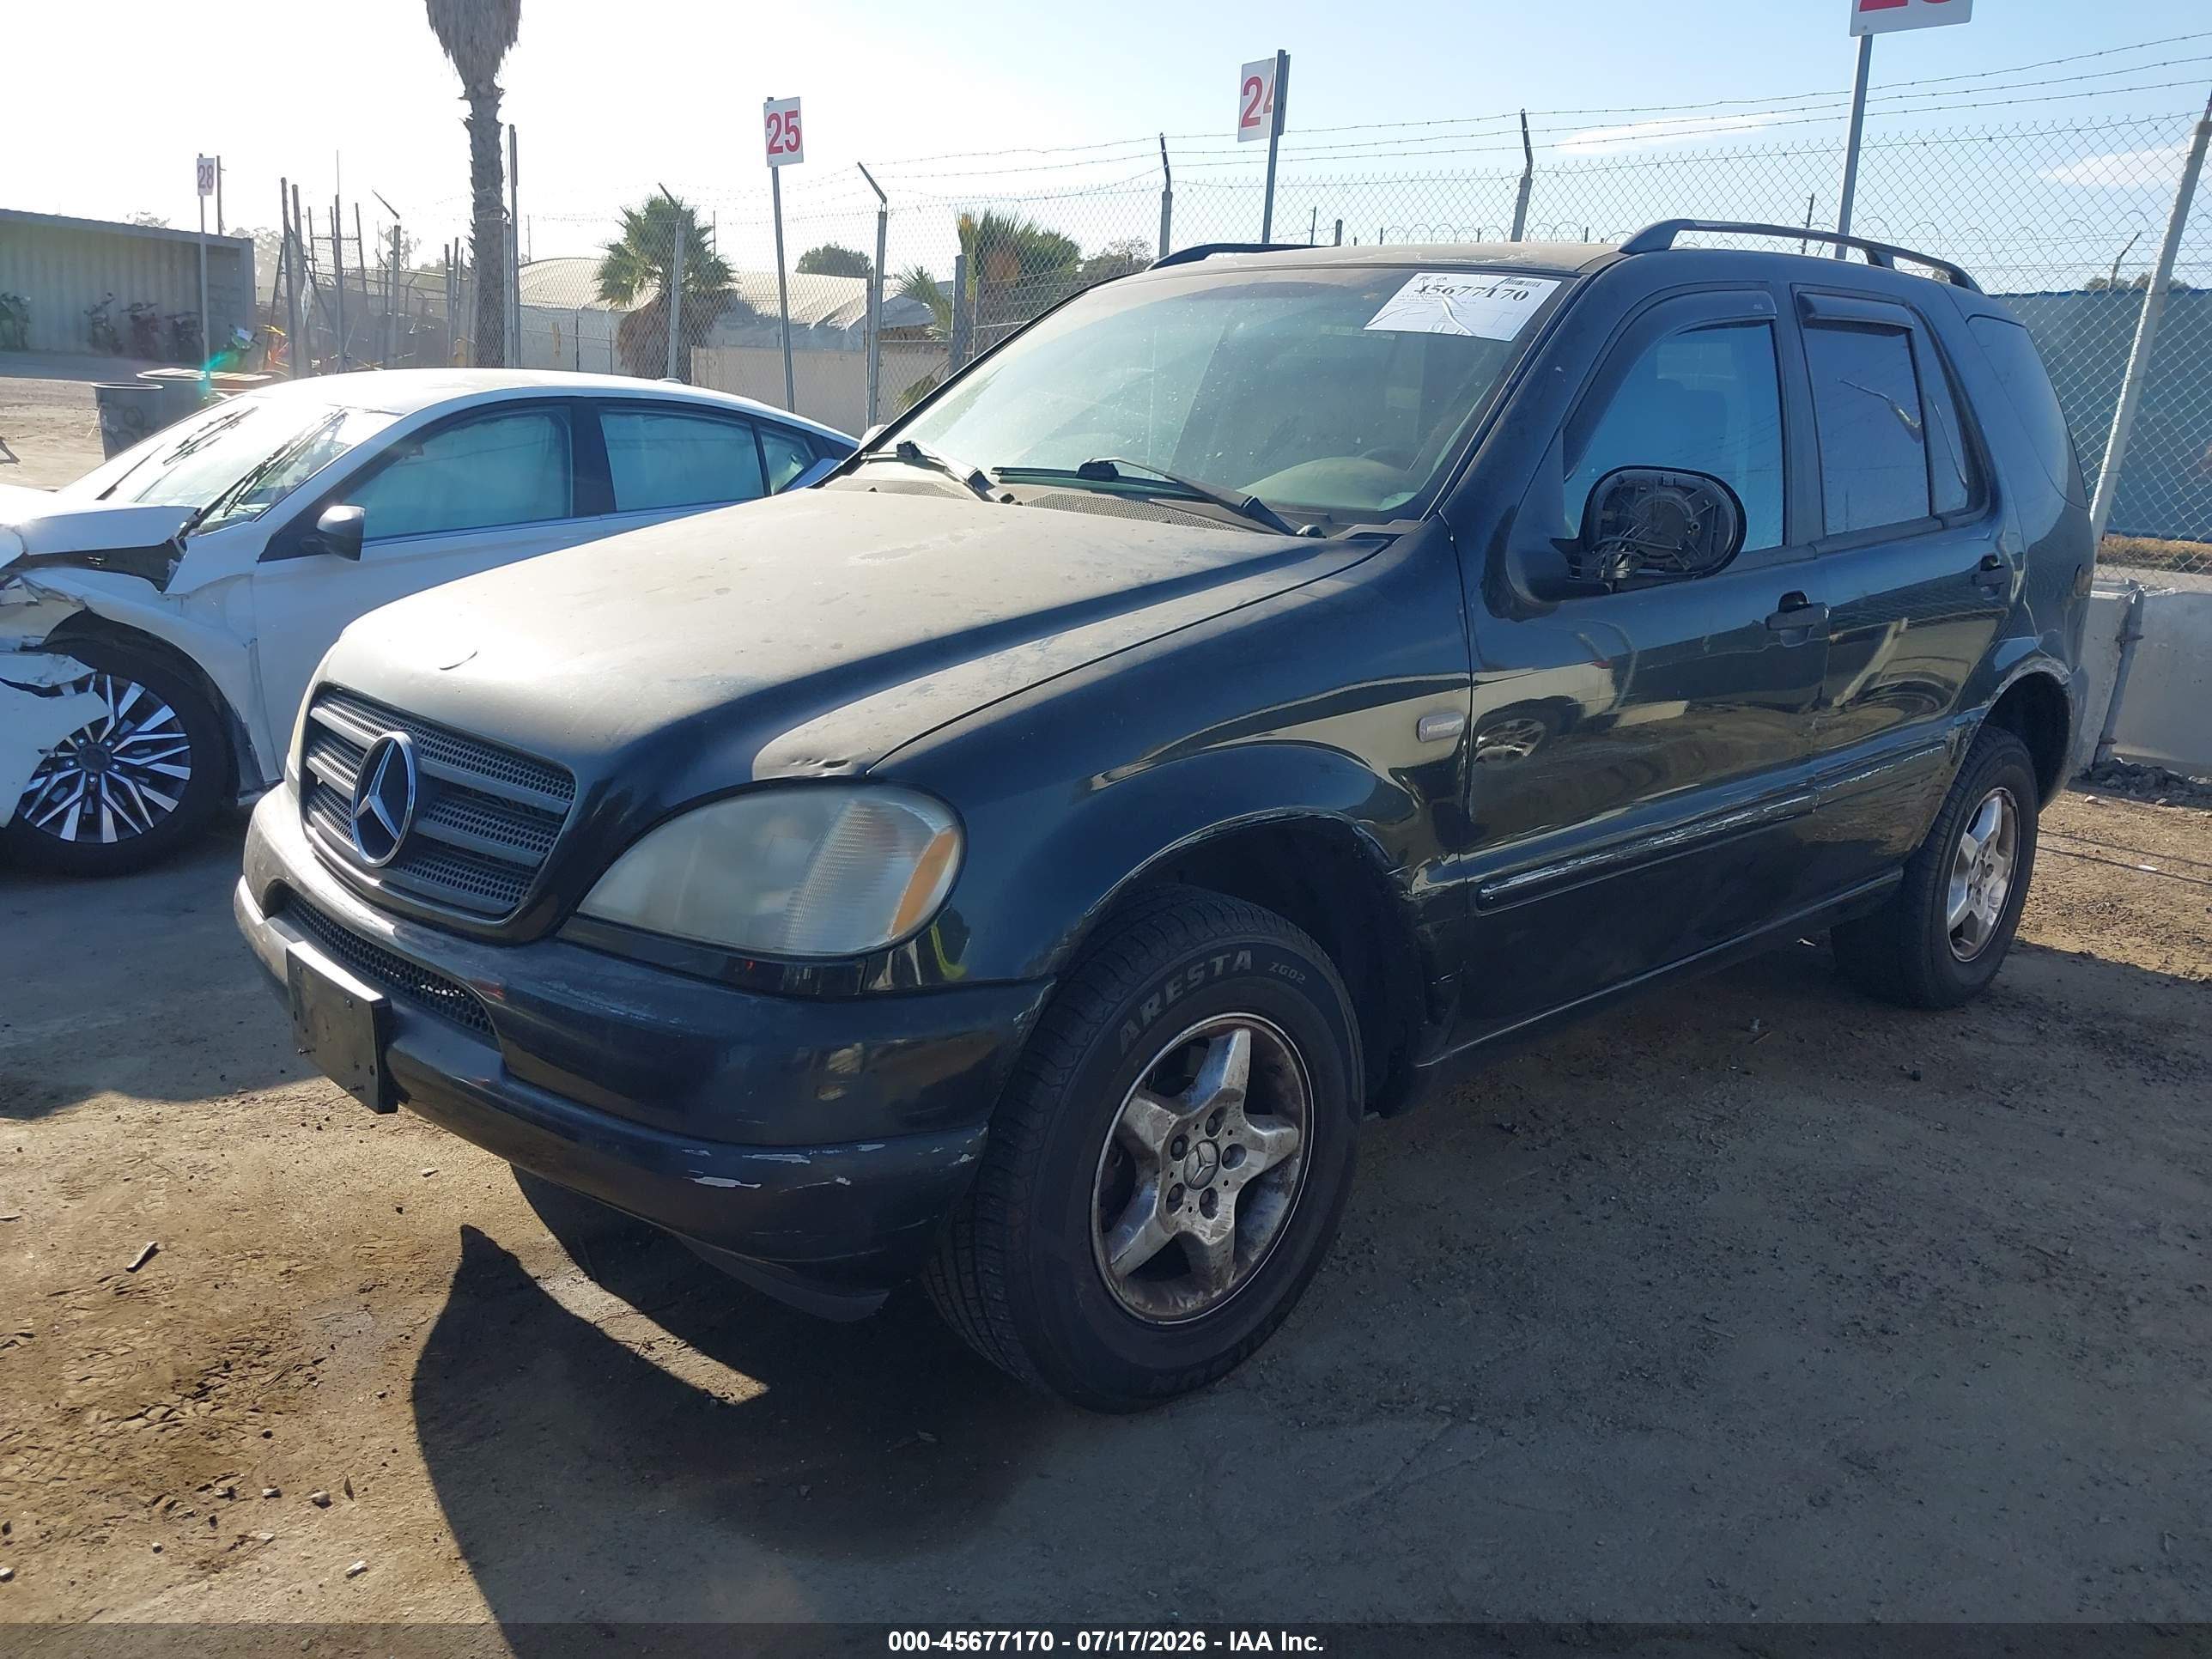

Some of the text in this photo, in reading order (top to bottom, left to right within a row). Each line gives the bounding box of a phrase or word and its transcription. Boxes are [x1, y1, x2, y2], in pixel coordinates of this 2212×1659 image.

[767, 110, 800, 154] 25
[198, 164, 214, 189] 28
[1119, 950, 1253, 1055] ARESTA
